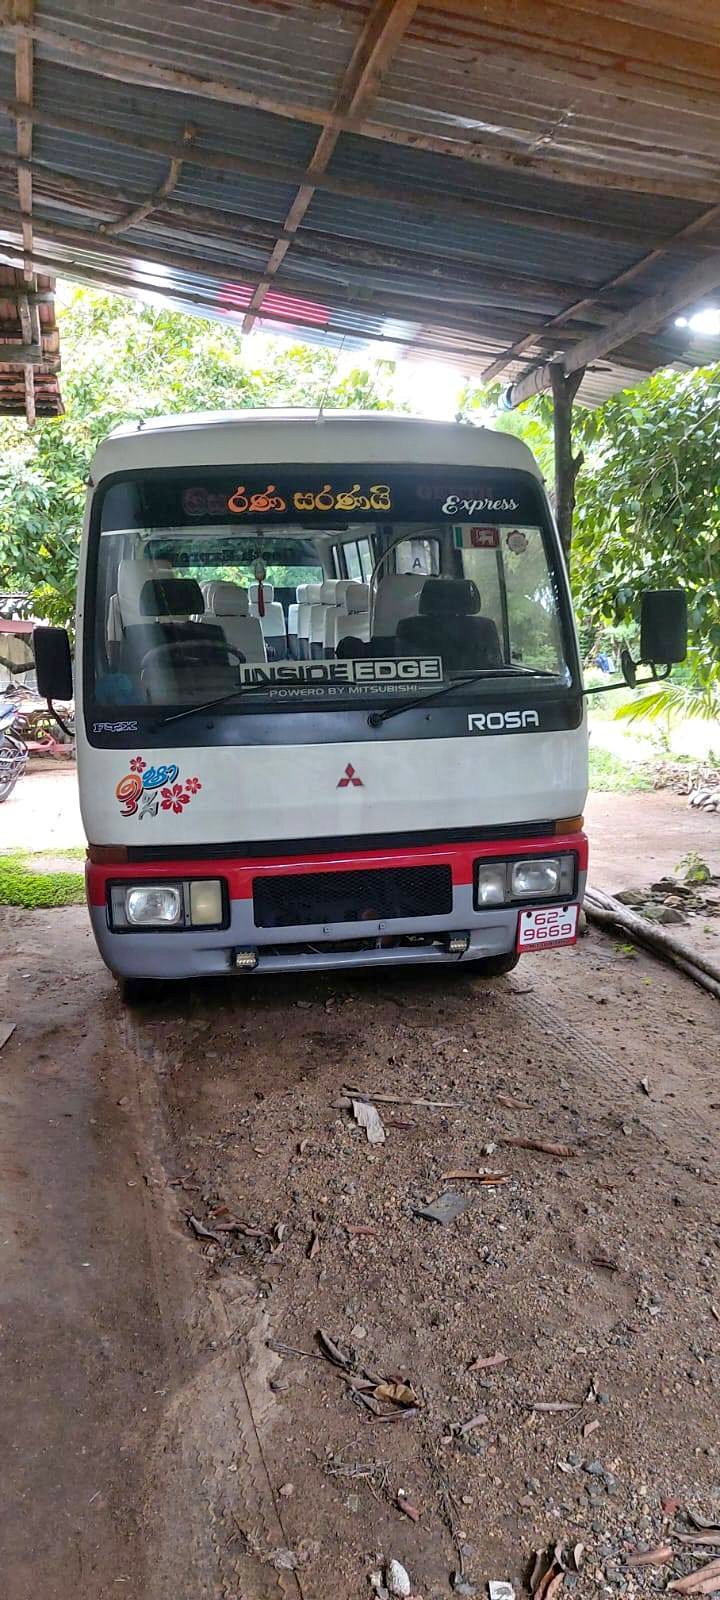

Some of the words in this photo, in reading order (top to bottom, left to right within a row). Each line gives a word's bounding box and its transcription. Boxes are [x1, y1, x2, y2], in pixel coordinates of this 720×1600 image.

[441, 495, 519, 515] Express
[412, 557, 422, 569] A
[244, 664, 349, 683] INSIDE
[355, 660, 439, 680] EDGE
[328, 687, 345, 695] BY
[348, 685, 417, 695] MITSUBISHI
[467, 710, 540, 731] ROSA
[534, 911, 566, 925] 62-
[523, 923, 572, 941] 9669
